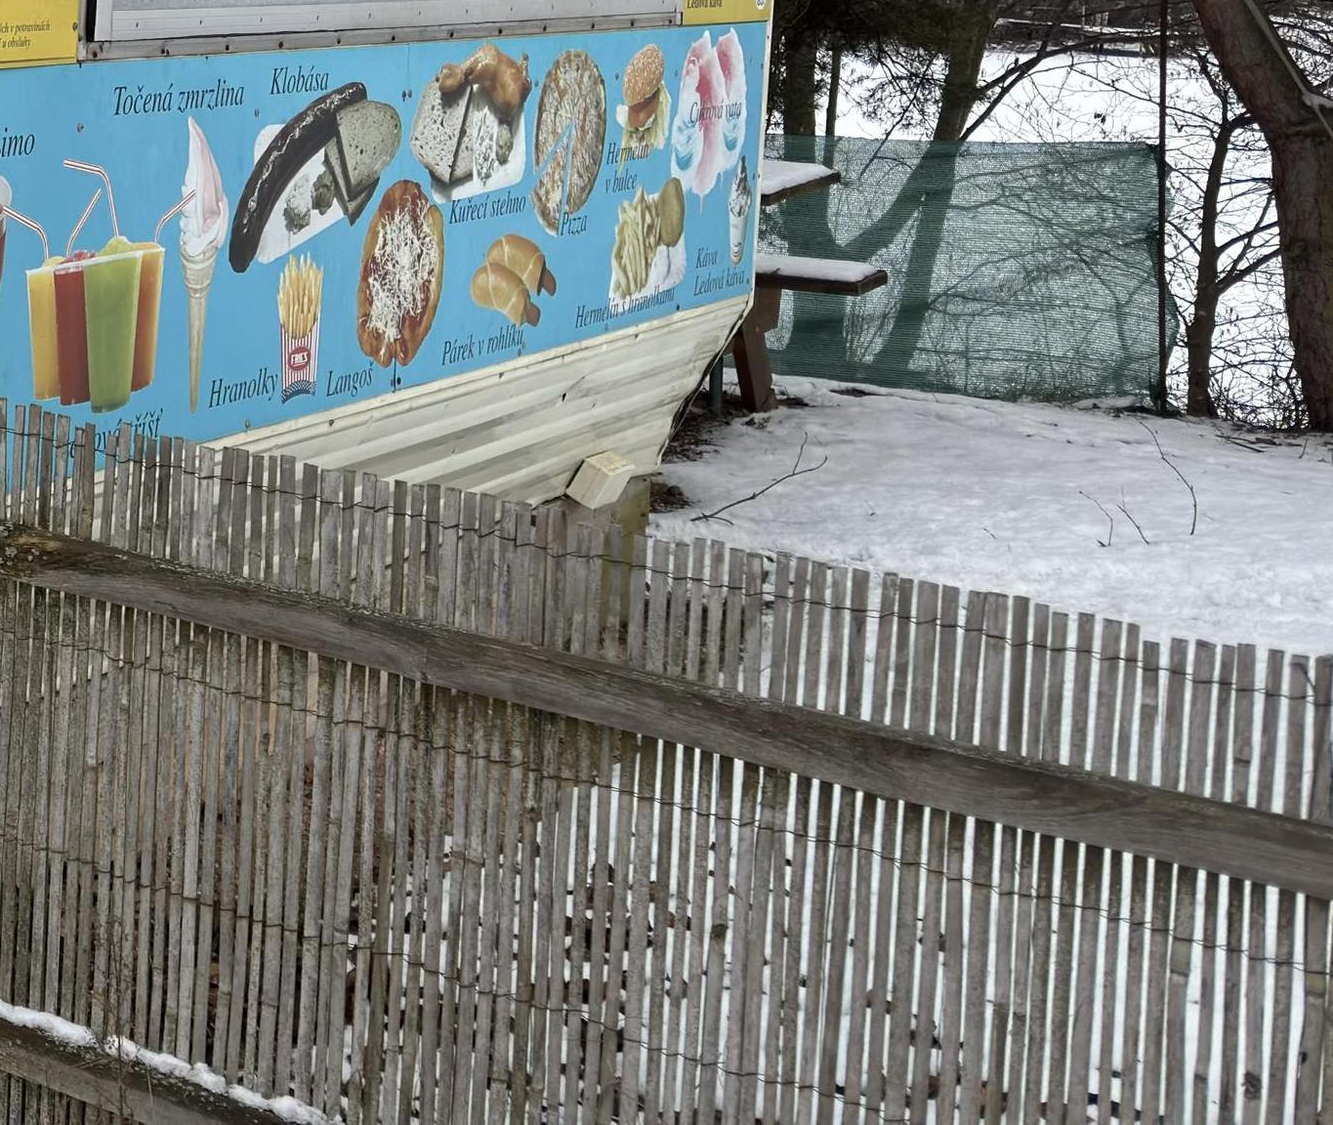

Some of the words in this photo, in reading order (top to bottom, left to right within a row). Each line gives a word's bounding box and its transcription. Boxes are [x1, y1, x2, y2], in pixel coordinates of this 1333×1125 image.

[269, 65, 330, 95] Klobása
[113, 83, 174, 116] Točená
[177, 79, 245, 114] zmrzlina
[605, 179, 612, 194] v
[612, 168, 638, 193] bulce
[449, 195, 490, 225] Kuřecí
[490, 190, 527, 218] stehno
[560, 211, 588, 236] Pizza
[696, 246, 718, 269] Káva
[694, 270, 724, 297] Ledová
[726, 266, 745, 287] káva
[575, 297, 619, 329] Hermelín
[621, 301, 626, 316] s
[441, 335, 473, 366] Párek
[478, 341, 484, 355] v
[486, 323, 524, 354] rohlíku
[208, 367, 279, 408] Hranolky
[326, 361, 374, 398] Langoš
